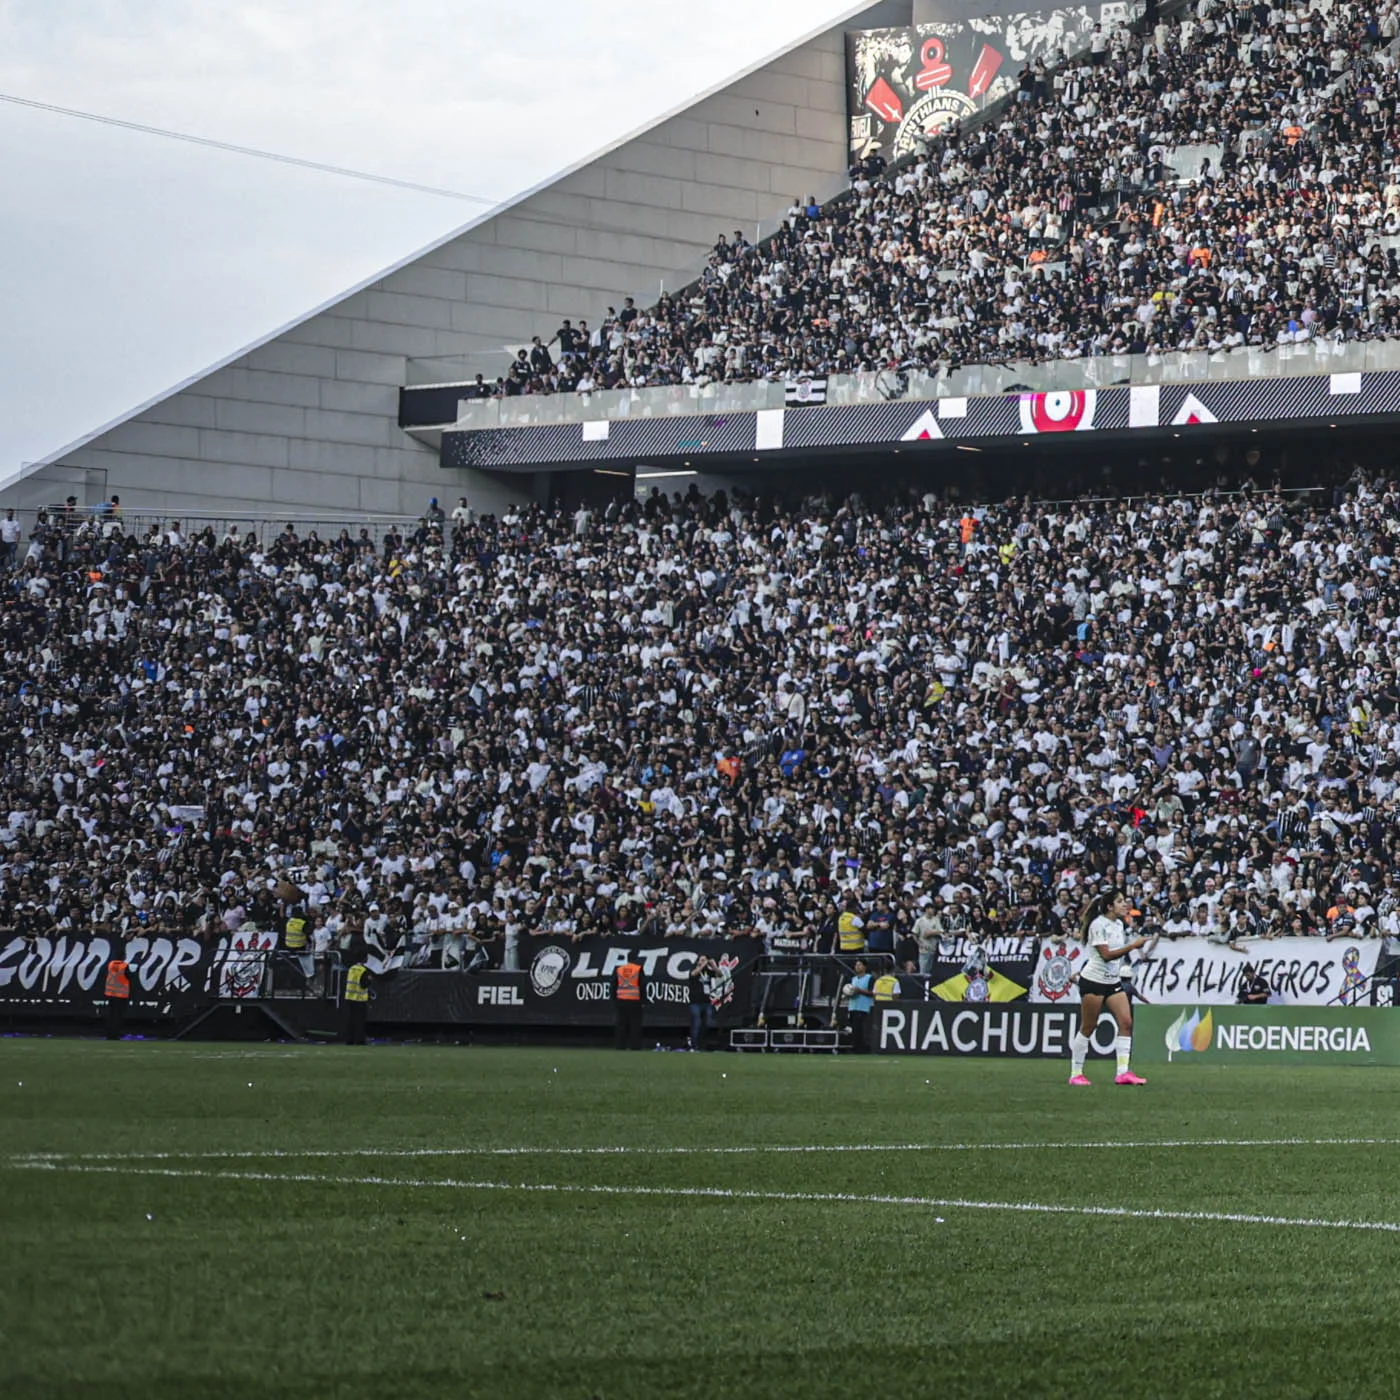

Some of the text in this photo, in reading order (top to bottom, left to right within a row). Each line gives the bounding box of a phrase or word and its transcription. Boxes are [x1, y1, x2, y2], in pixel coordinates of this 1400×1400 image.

[478, 986, 524, 1005] FIEL
[576, 982, 691, 1004] ONDE QUISER
[1217, 1025, 1371, 1052] NEOENERGIA
